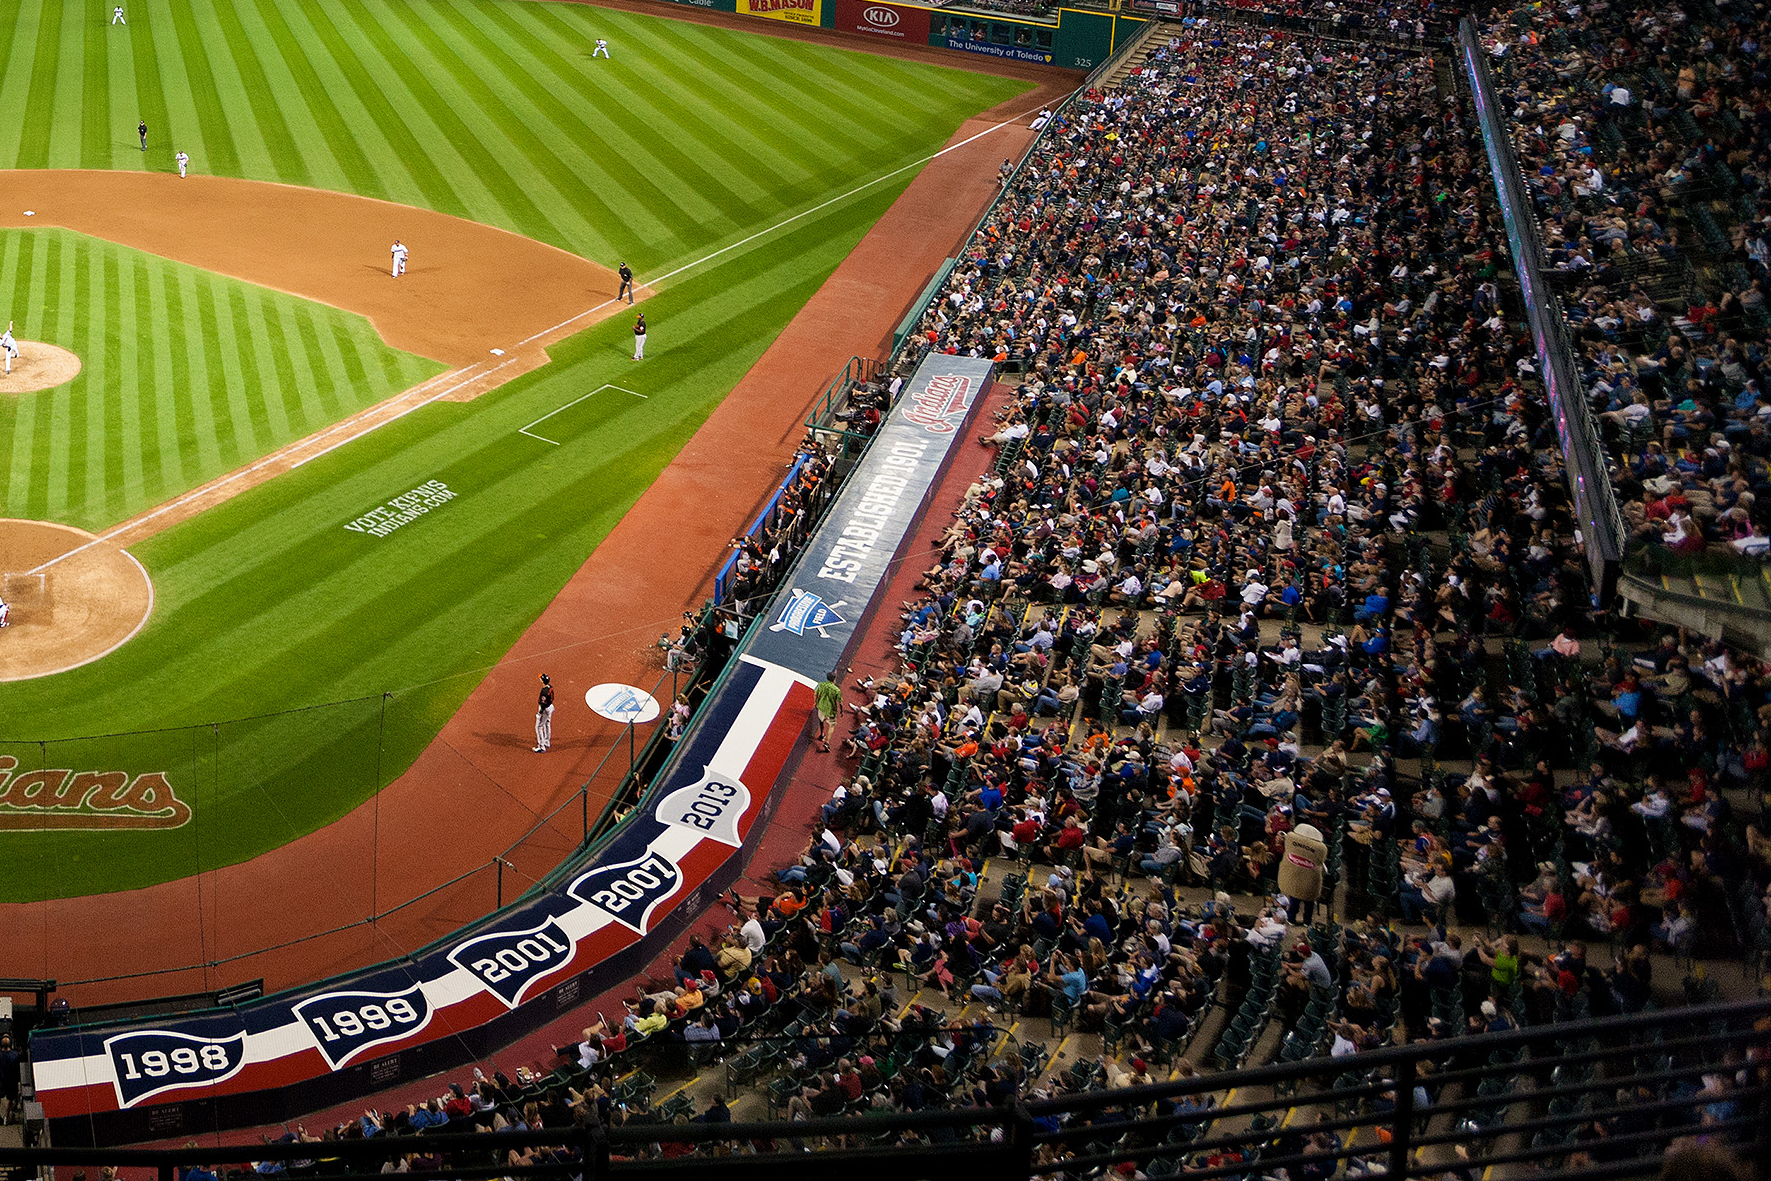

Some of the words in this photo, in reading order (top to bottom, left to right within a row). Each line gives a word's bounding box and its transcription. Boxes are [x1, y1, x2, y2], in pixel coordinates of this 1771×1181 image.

[869, 10, 893, 24] KIA
[949, 40, 963, 49] The
[965, 43, 1004, 57] University
[1005, 49, 1014, 58] of
[1016, 50, 1044, 62] Toledo
[1074, 58, 1091, 67] 325
[900, 373, 973, 434] Indians
[343, 506, 396, 532] VOTE
[388, 479, 447, 510] KIPNIS
[367, 489, 458, 538] INDIANS.COM
[817, 471, 910, 584] ESTABLISHED
[813, 608, 826, 625] FIELD
[680, 780, 737, 832] 2013
[591, 855, 675, 913] 2007
[473, 932, 568, 984] 2001
[317, 1000, 416, 1041] 1999
[119, 1044, 229, 1080] 1998
